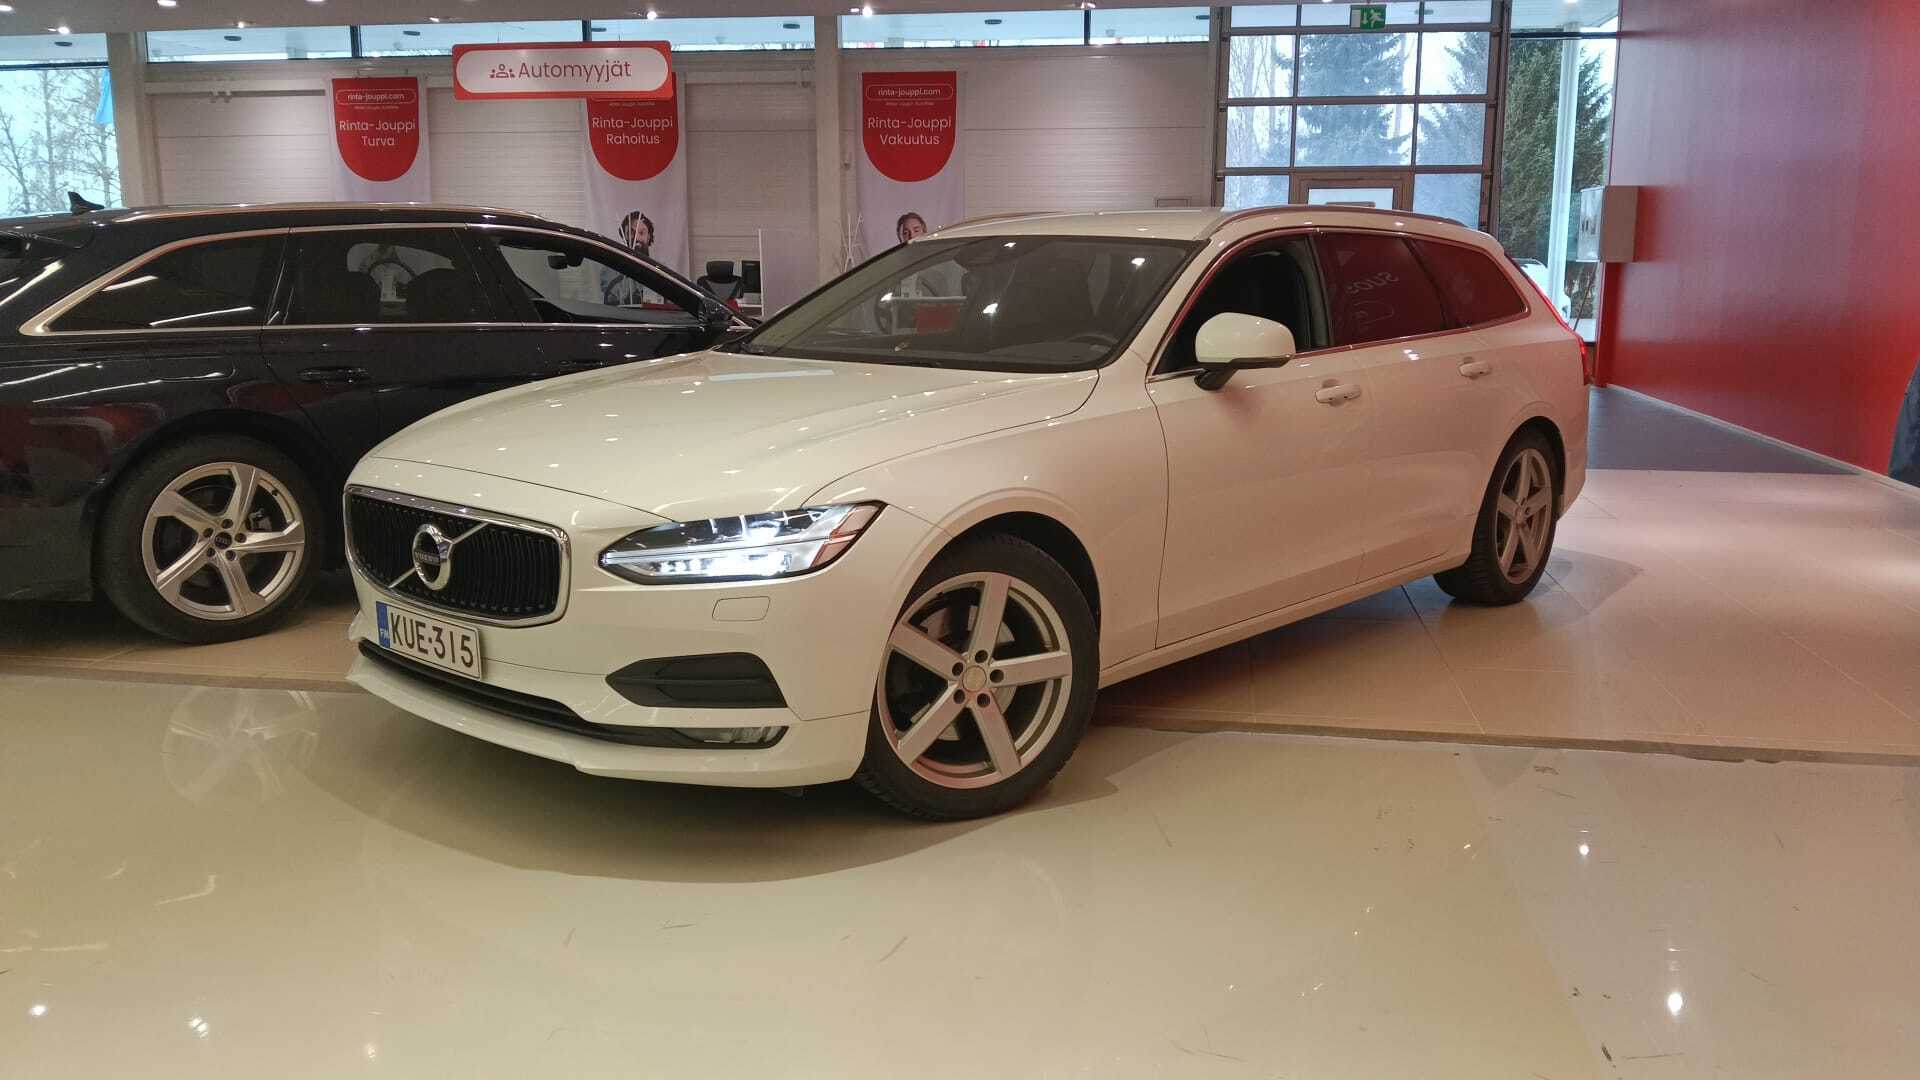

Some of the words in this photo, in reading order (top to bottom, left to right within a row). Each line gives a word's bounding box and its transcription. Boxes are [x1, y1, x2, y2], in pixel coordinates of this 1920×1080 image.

[518, 60, 632, 82] Automyyjät
[347, 92, 405, 102] rinta-jouppi.com
[878, 88, 941, 98] rinta-jouppi.com
[339, 119, 416, 133] Rinta-Jouppi
[592, 116, 673, 131] Rinta-Jouppi
[868, 116, 952, 131] Rinta-Jouppi
[362, 136, 395, 147] Turva
[606, 133, 661, 145] Rahoitus
[879, 134, 940, 146] Vakuutus
[390, 612, 474, 668] KUE-315
